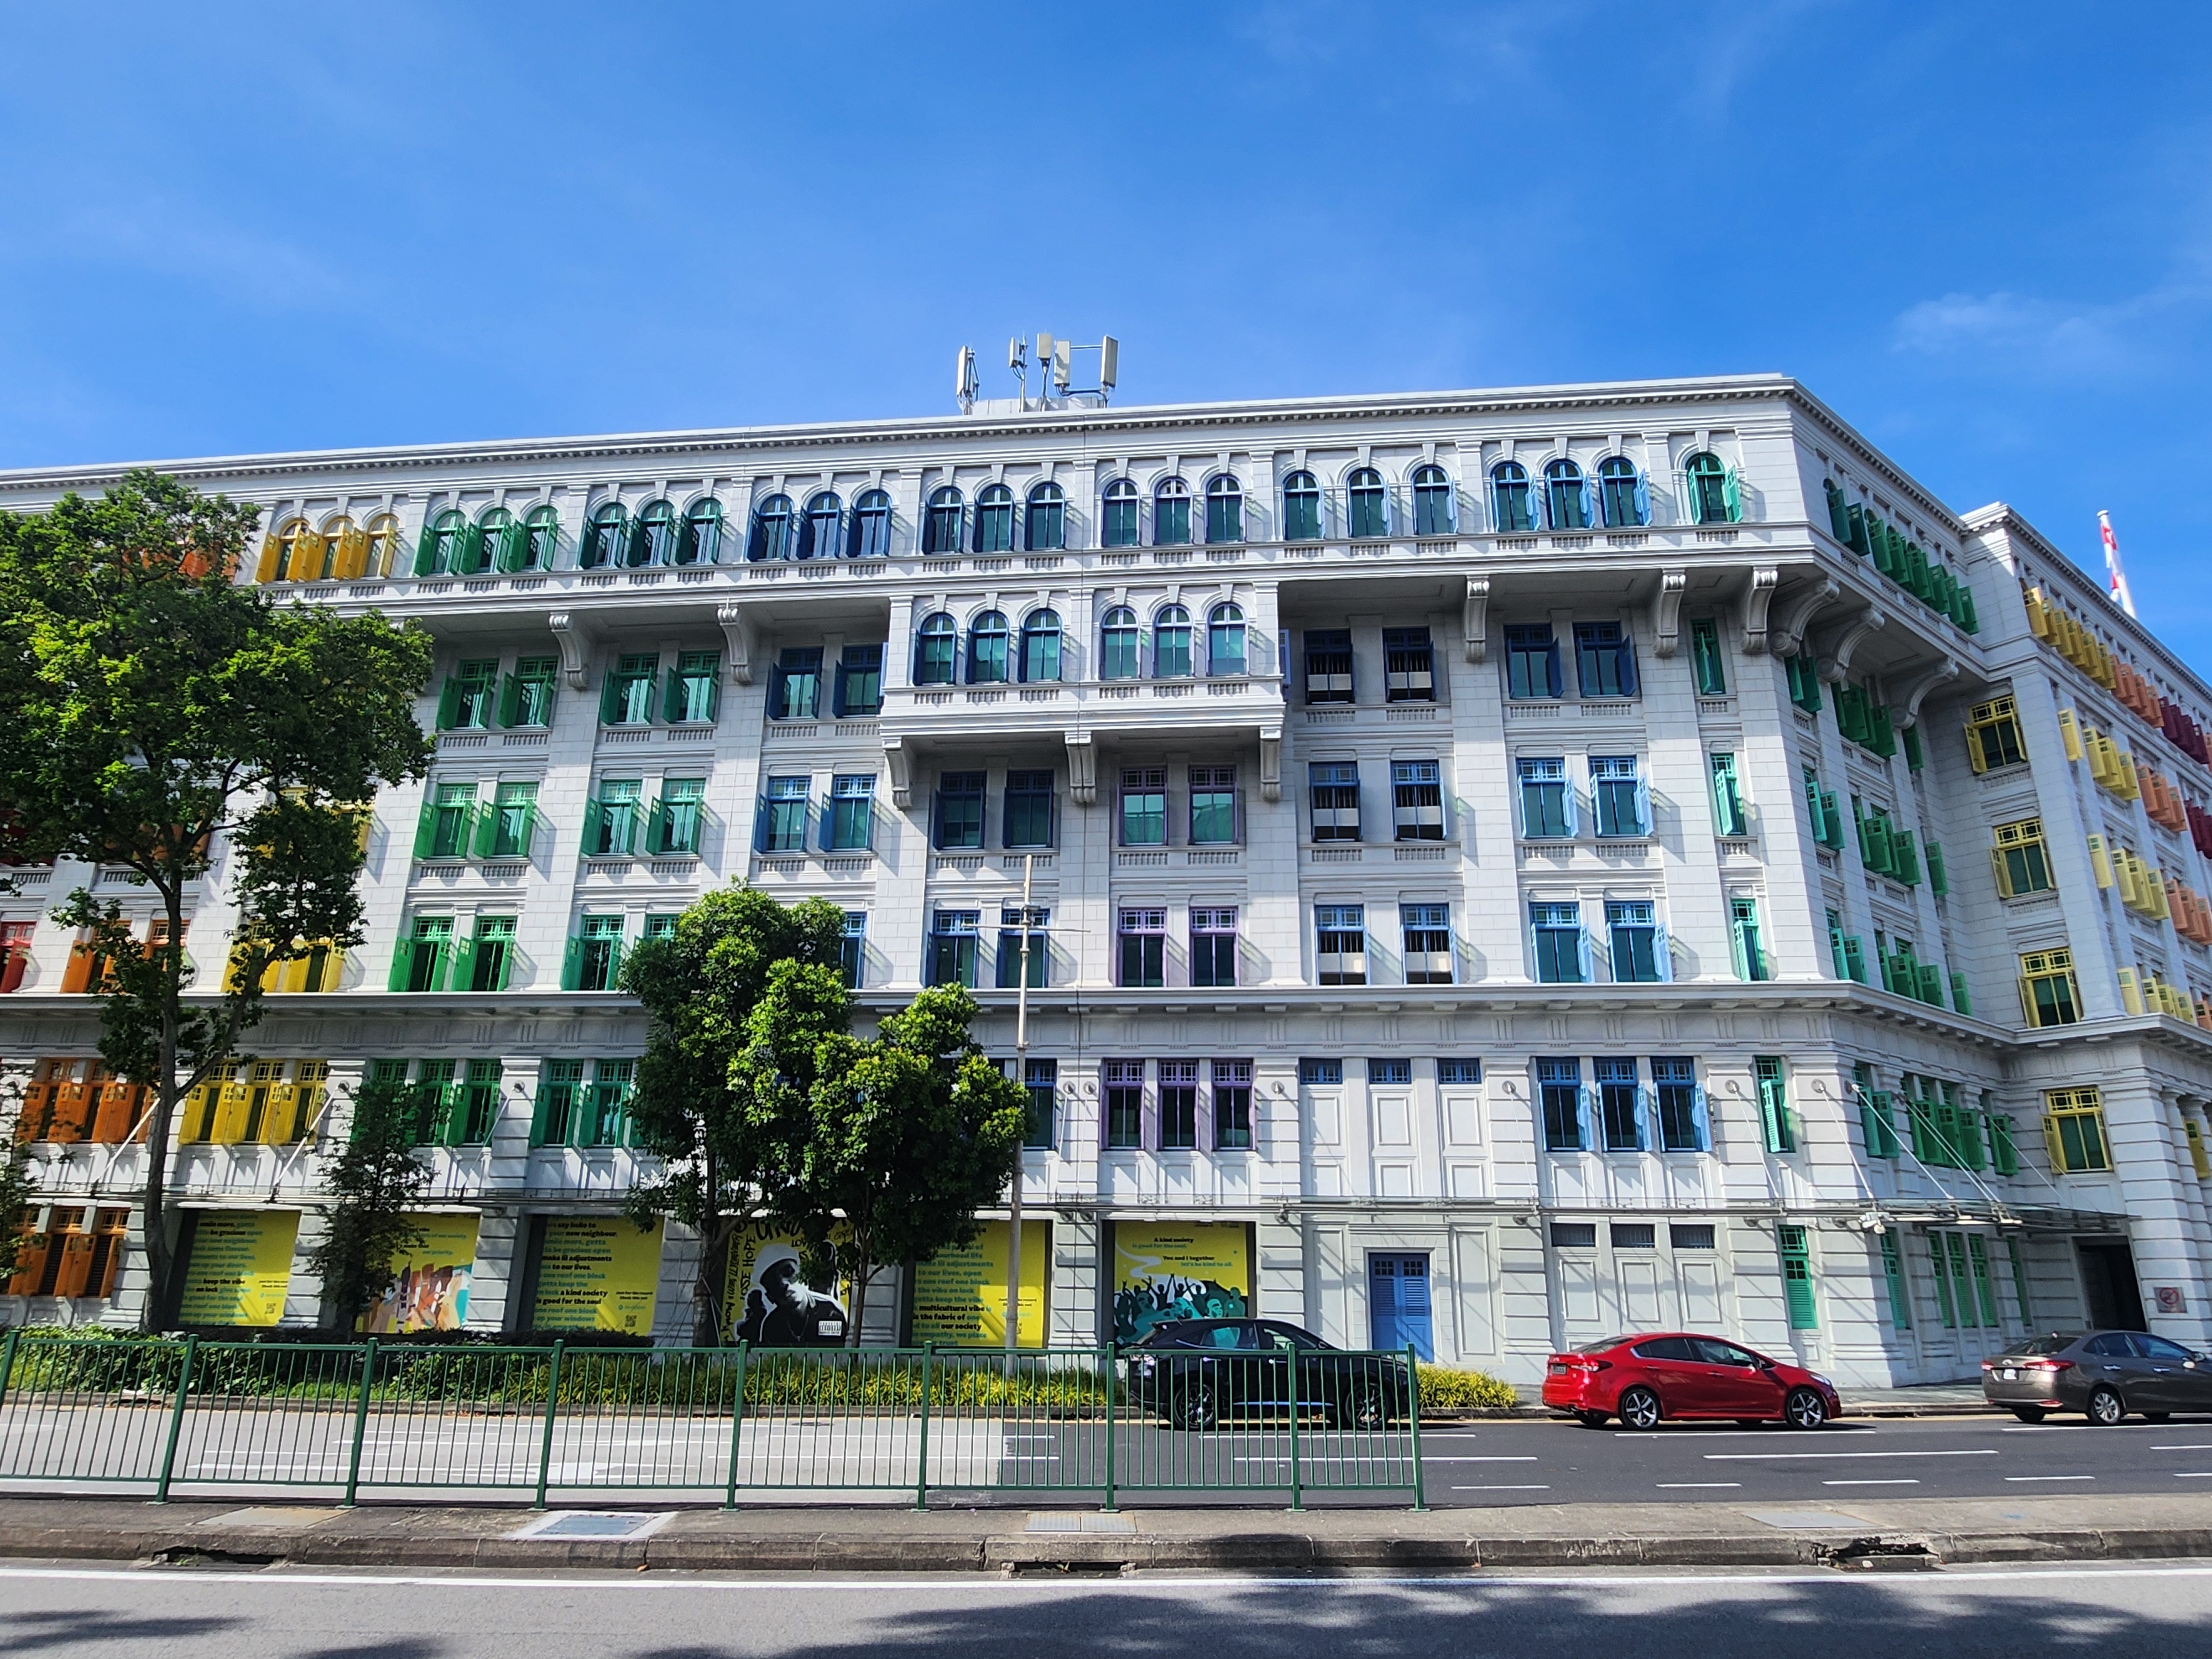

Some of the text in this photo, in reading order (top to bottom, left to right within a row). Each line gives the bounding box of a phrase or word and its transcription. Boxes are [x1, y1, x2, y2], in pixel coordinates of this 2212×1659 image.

[742, 1234, 756, 1267] HOPE
[582, 1289, 608, 1297] society
[955, 1322, 982, 1332] society
